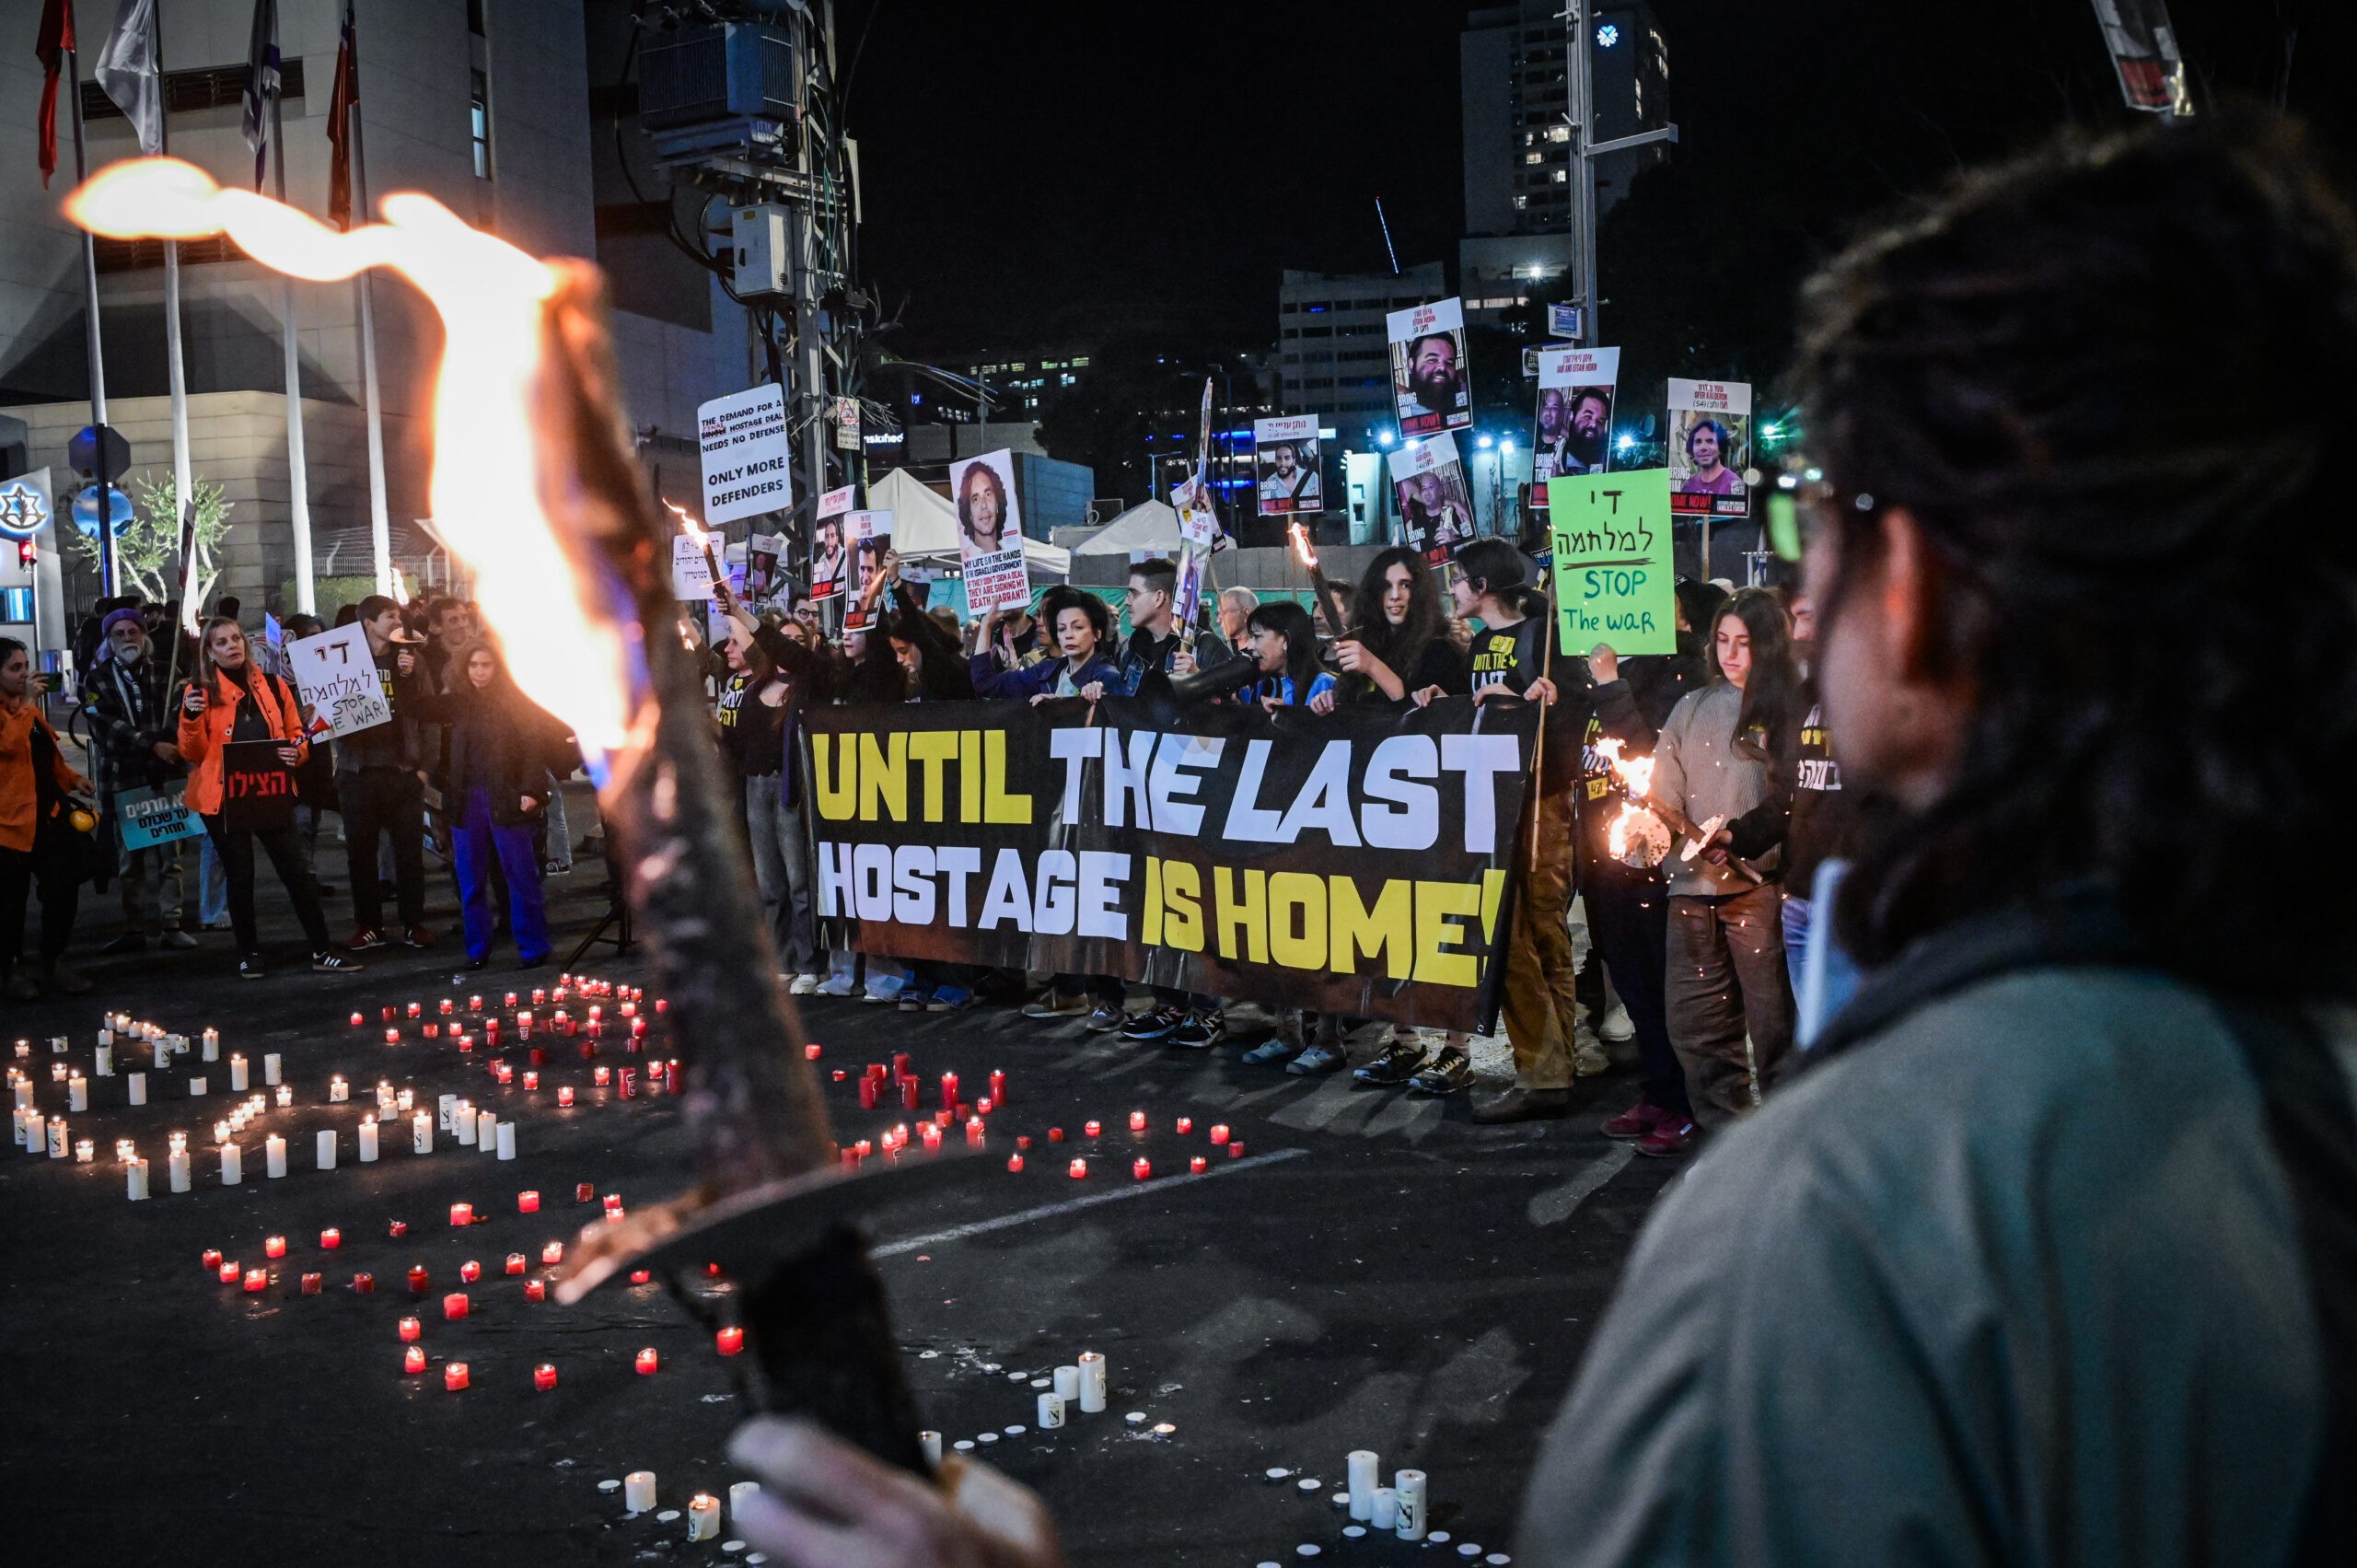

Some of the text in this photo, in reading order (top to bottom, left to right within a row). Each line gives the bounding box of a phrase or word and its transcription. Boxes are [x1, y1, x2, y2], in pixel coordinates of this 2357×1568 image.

[1398, 392, 1417, 407] BRING
[702, 417, 716, 427] THE
[720, 407, 754, 422] DEMAND
[758, 402, 772, 412] FOR
[730, 418, 762, 432] HOSTAGE
[766, 413, 783, 422] DEAL
[702, 425, 785, 453] NEEDS NO DEFENSE
[1535, 453, 1554, 467] BRING
[708, 457, 784, 485] ONLY MORE
[712, 480, 783, 506] DEFENDERS
[1260, 481, 1276, 490] BRING
[1591, 490, 1625, 515] די
[1671, 495, 1687, 507] OME
[1689, 495, 1711, 508] NOW!
[1407, 528, 1426, 543] BRING
[1557, 516, 1653, 555] למלחמה
[964, 561, 972, 569] MY
[972, 558, 984, 567] LIFE
[992, 553, 1002, 563] THE
[1003, 550, 1021, 560] HANDS
[975, 566, 992, 576] ISRAELI
[992, 560, 1022, 573] GOVERNMENT
[967, 580, 971, 589] IF
[971, 578, 983, 587] THEY
[983, 576, 995, 585] DON'T
[996, 573, 1007, 582] SIGN
[1012, 570, 1024, 578] DEAL
[969, 578, 1025, 598] THEY ARE SIGNING MY
[1584, 570, 1646, 598] STOP
[970, 595, 991, 609] DEATH
[1563, 609, 1600, 630] The
[315, 640, 350, 664] די
[1492, 653, 1507, 670] THE
[302, 669, 371, 703] למלחמה
[332, 695, 366, 716] STOP
[351, 695, 387, 726] WAR!
[228, 771, 287, 798] הצילו
[812, 729, 1033, 824] UNTIL
[1050, 727, 1225, 836] THE
[1222, 734, 1521, 853] LAST
[125, 791, 184, 818] א מרפים
[139, 808, 189, 828] עד שכולם
[151, 822, 186, 839] חוזרים
[818, 841, 1507, 988] HOSTAGE IS HOME!
